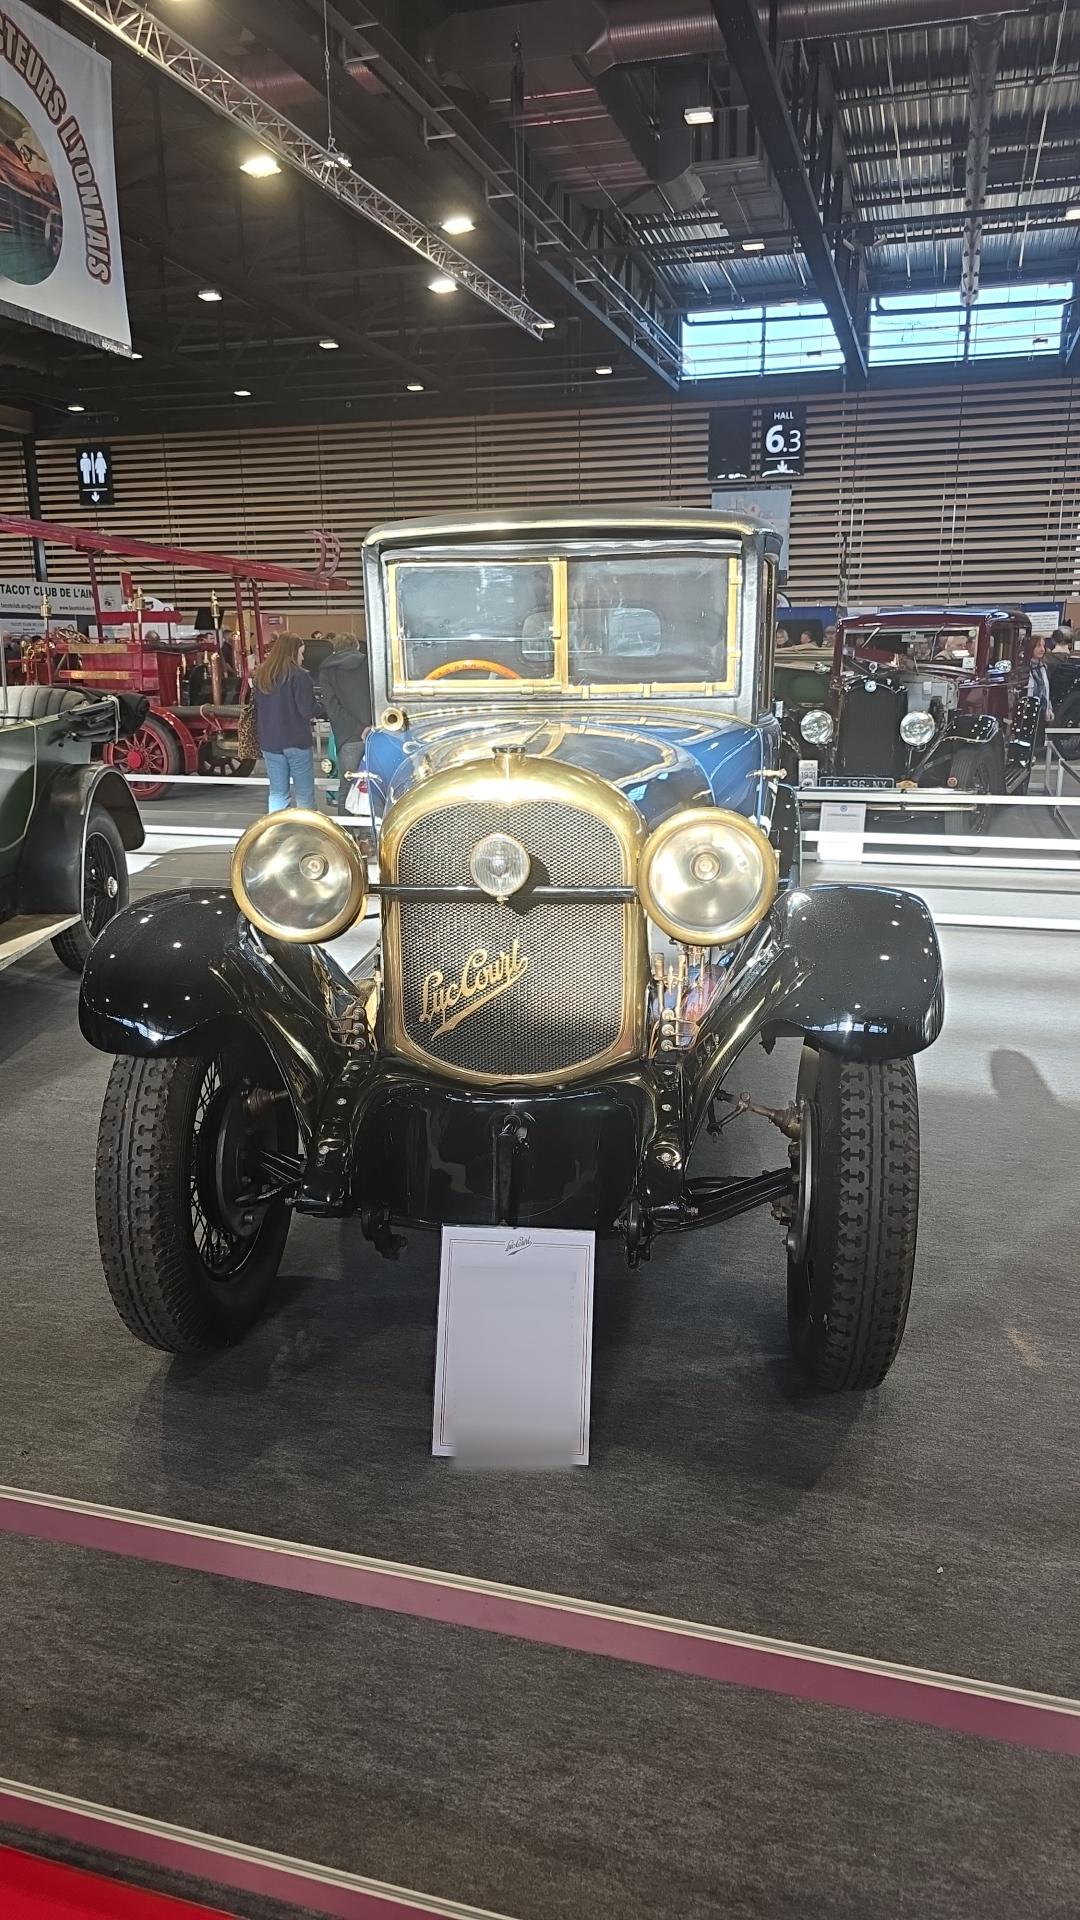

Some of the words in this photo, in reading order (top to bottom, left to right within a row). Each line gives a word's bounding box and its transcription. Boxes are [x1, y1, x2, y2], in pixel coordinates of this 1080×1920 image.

[0, 10, 67, 125] TEURS
[57, 115, 112, 286] LYONNAIS
[773, 411, 795, 420] HALL
[765, 424, 801, 454] 6.3
[0, 584, 31, 595] TACOT
[33, 586, 57, 597] CLUB
[60, 588, 71, 598] DE
